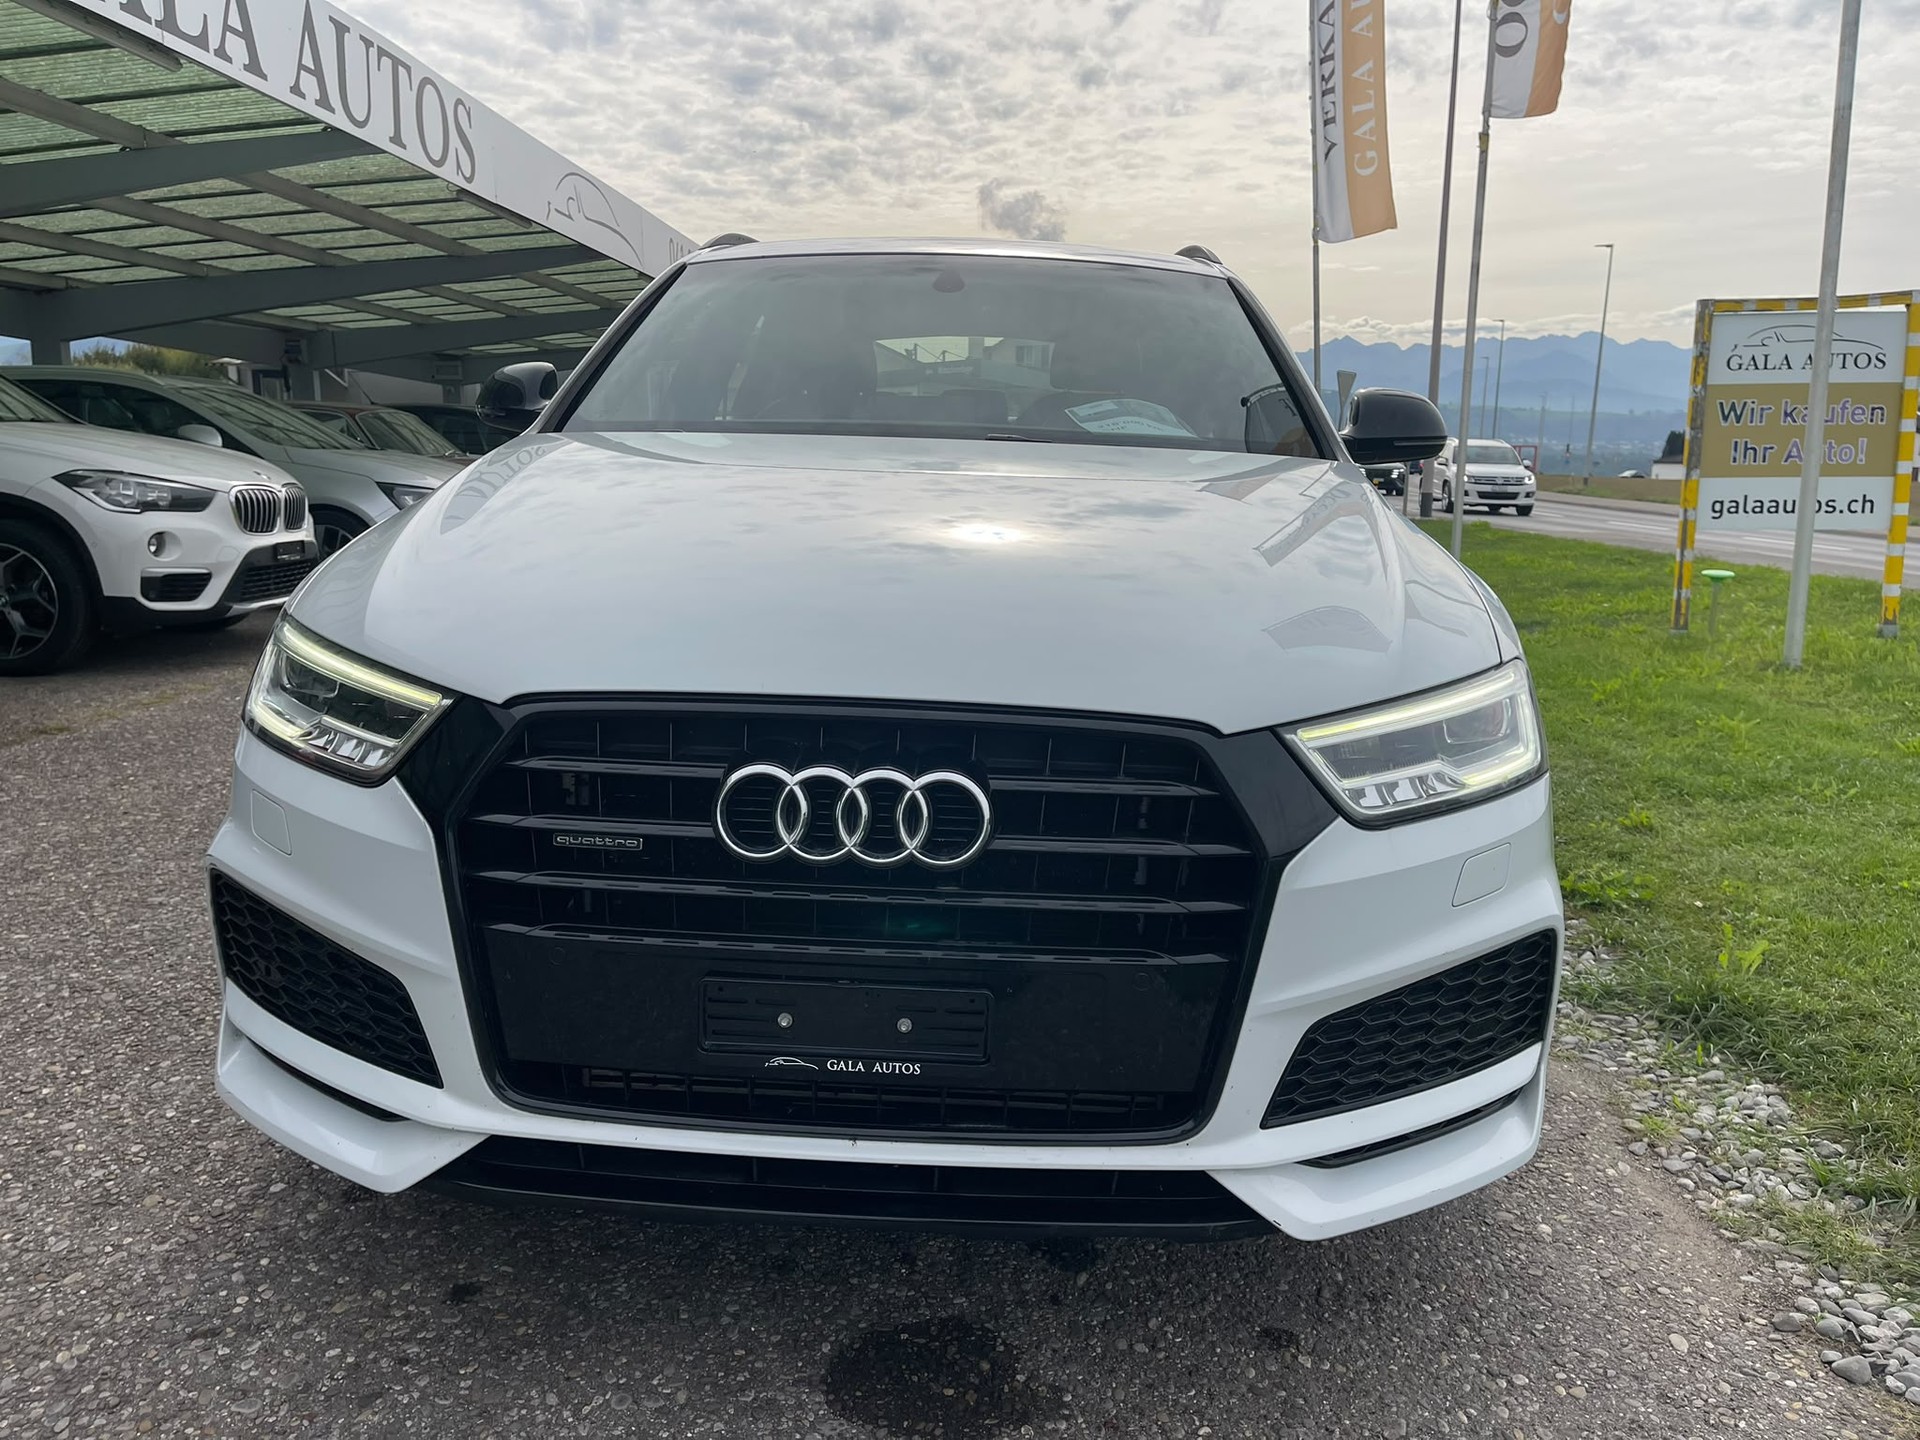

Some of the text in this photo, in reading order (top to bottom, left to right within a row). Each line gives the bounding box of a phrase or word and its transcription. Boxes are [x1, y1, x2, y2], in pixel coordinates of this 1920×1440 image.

[289, 0, 476, 184] AUTOS
[1351, 59, 1378, 177] GALA
[1726, 353, 1793, 371] GALA
[1718, 400, 1774, 425] Wir
[1731, 438, 1867, 465] Ihr Ato!
[1711, 494, 1875, 519] galaaus.ch
[557, 835, 638, 848] quattro
[827, 1059, 921, 1075] GALA AUTOS
